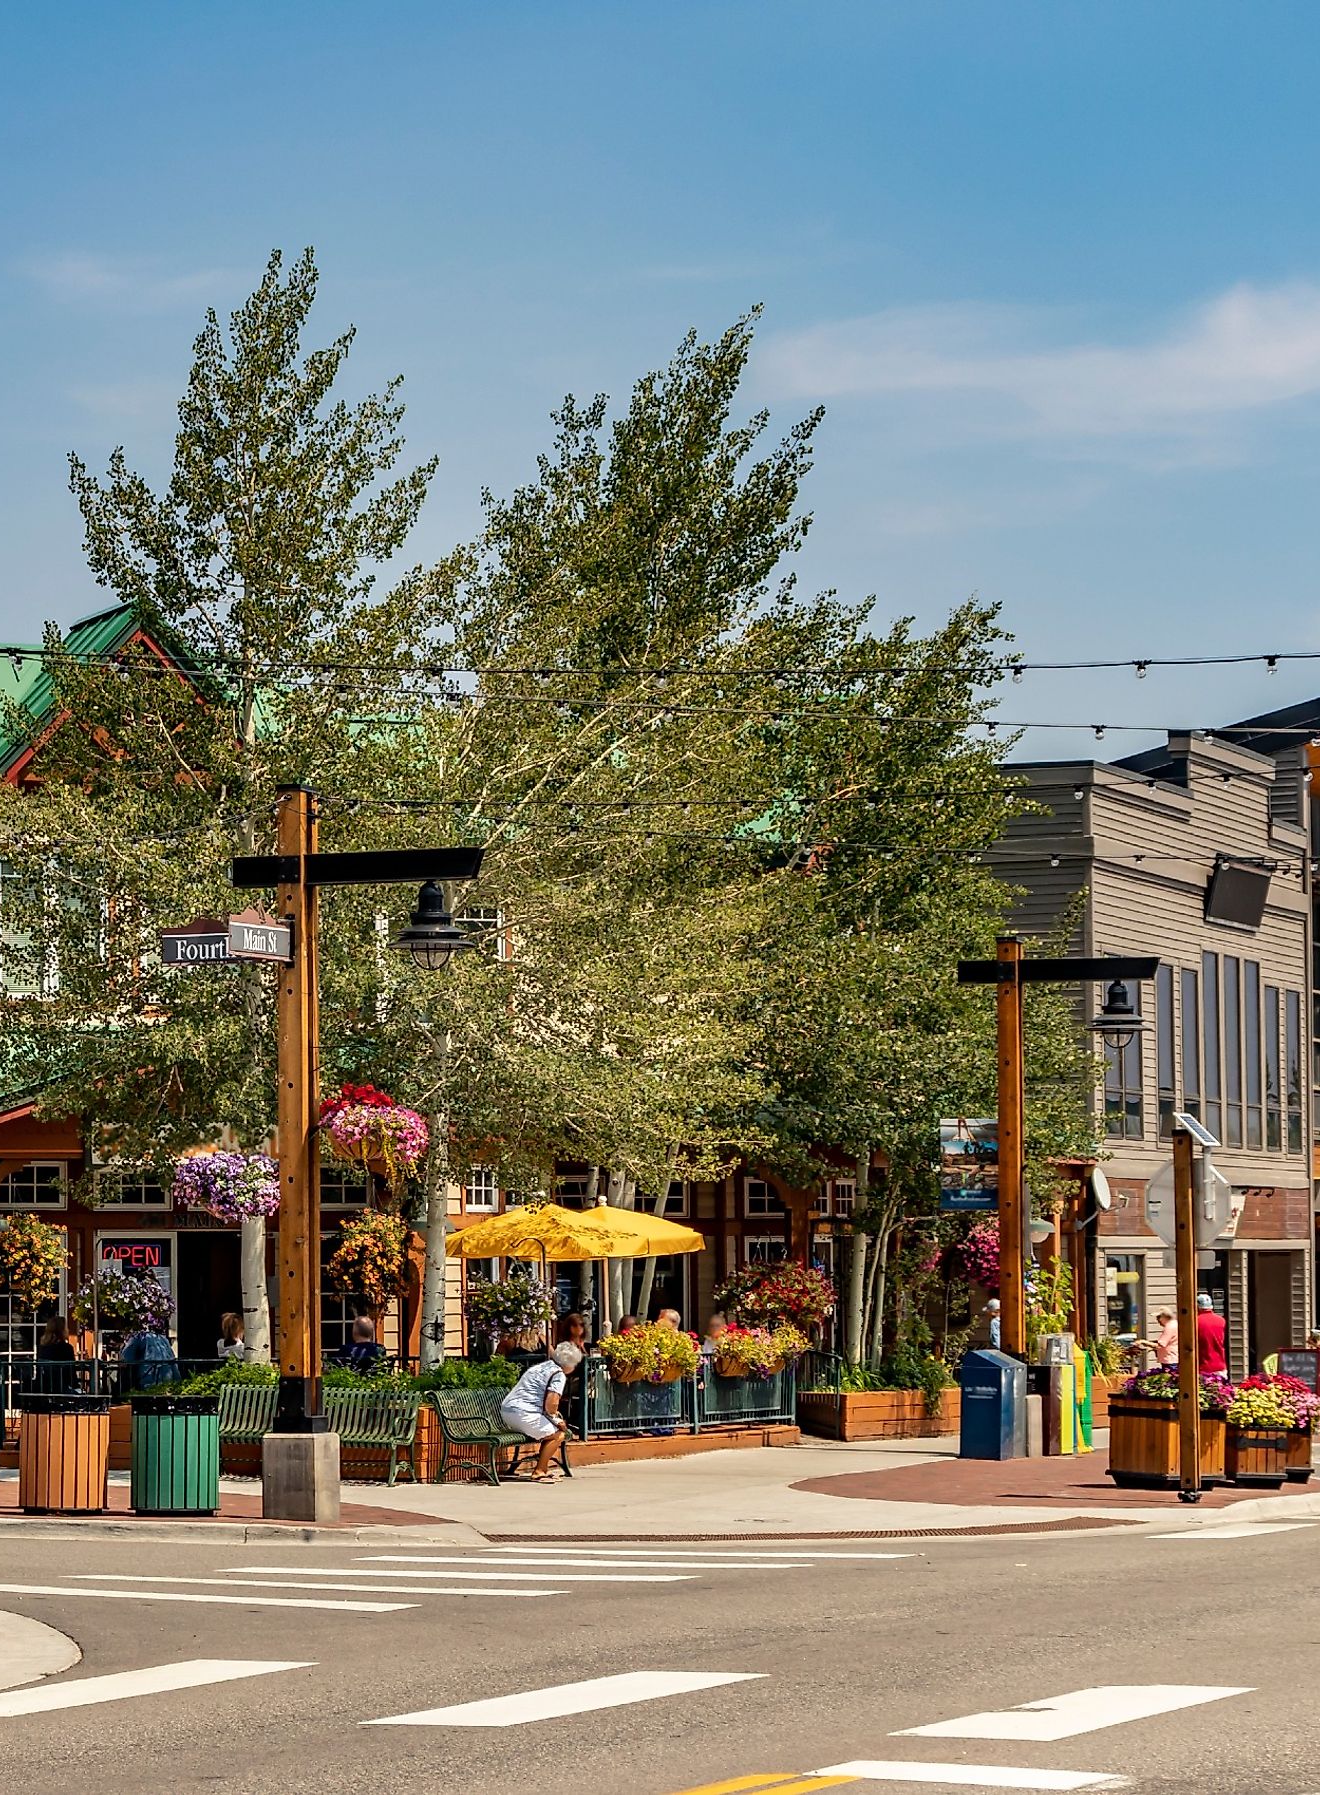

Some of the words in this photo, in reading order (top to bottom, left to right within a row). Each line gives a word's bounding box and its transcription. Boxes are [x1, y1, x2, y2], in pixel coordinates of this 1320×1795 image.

[243, 928, 266, 952] Main
[268, 931, 278, 953] St
[104, 1246, 160, 1266] OPEN
